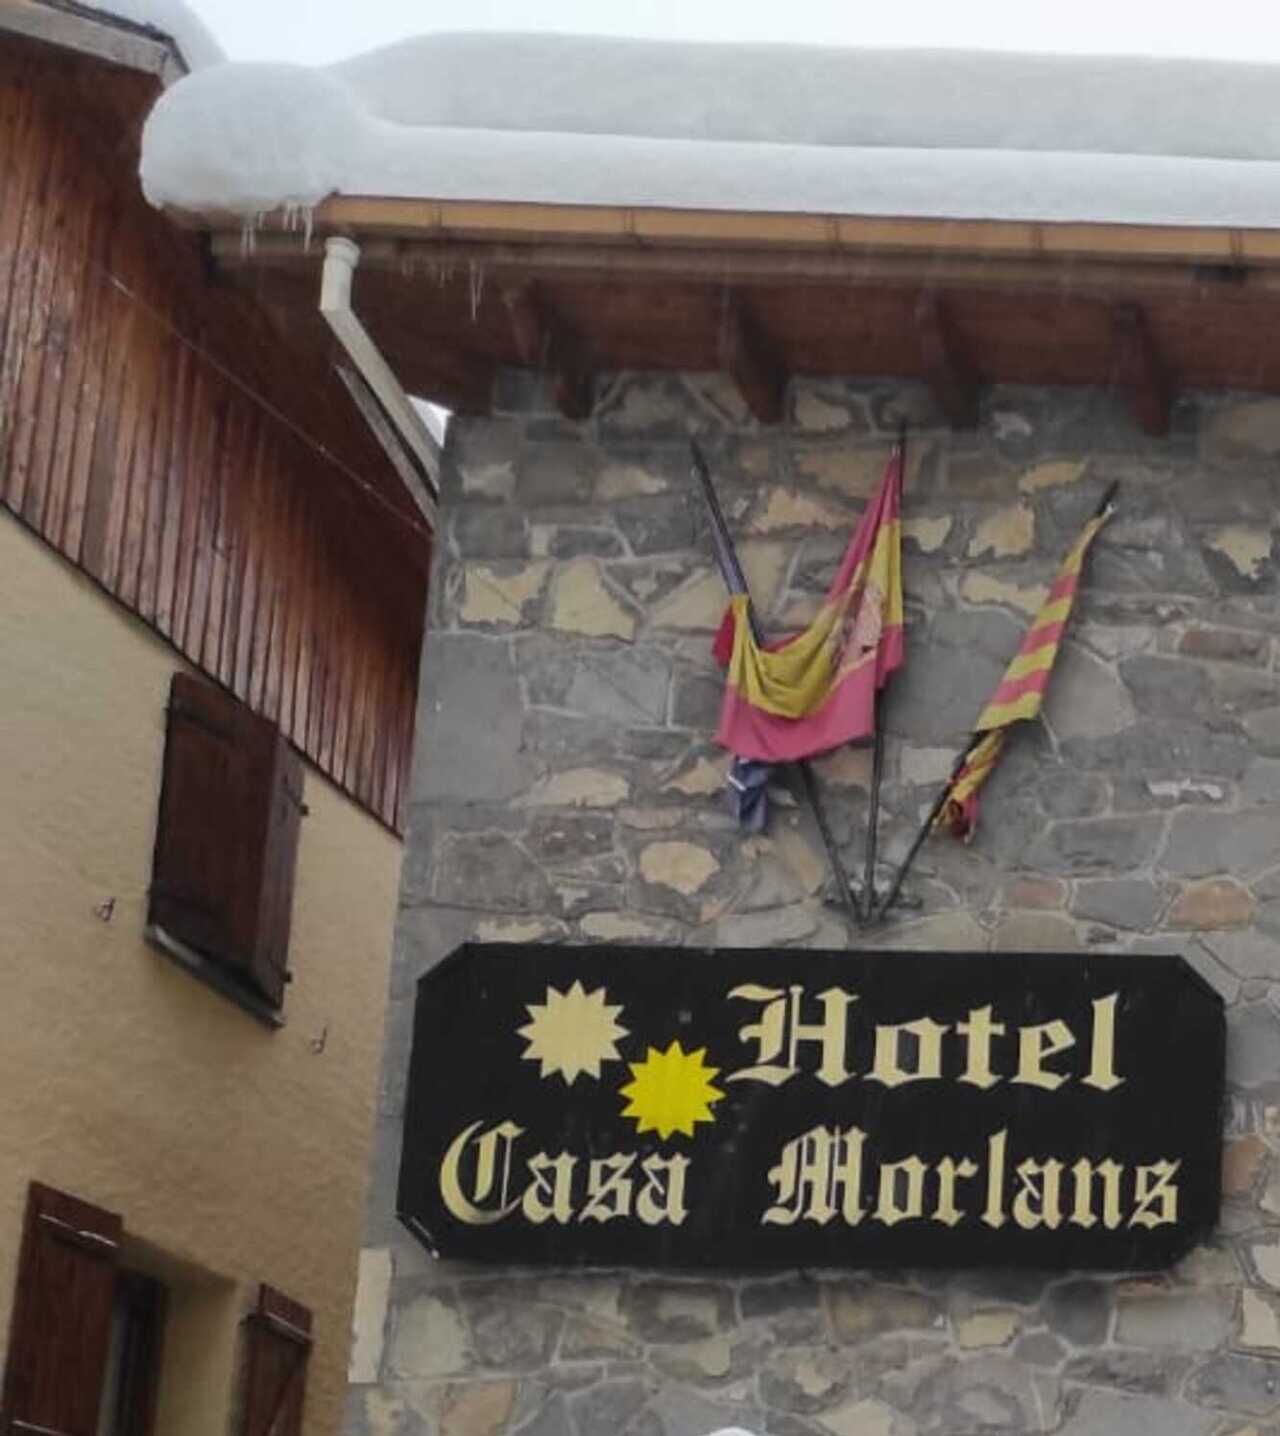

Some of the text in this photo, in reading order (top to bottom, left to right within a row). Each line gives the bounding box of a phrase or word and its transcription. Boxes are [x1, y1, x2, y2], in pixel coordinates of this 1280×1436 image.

[725, 983, 1126, 1093] Hotel
[438, 1119, 1182, 1231] Casa Morlans
